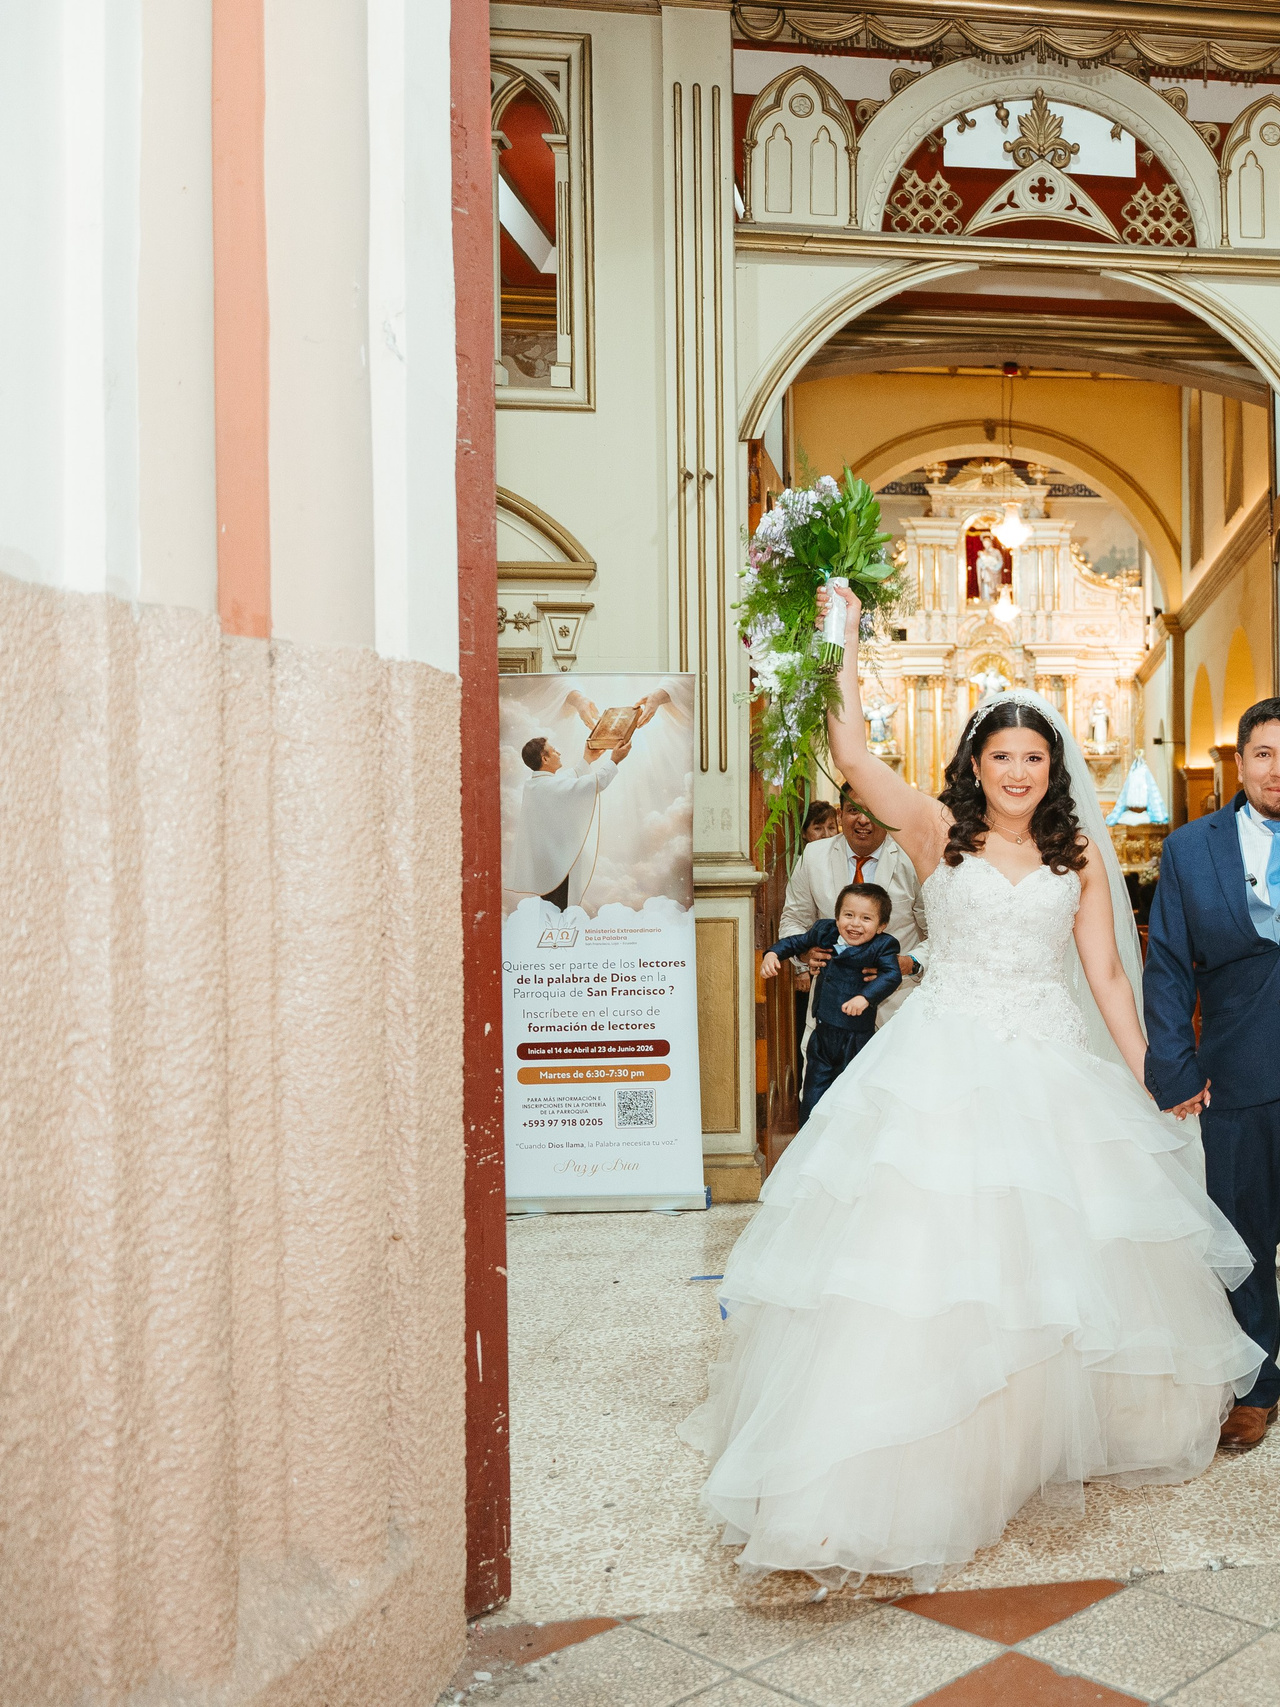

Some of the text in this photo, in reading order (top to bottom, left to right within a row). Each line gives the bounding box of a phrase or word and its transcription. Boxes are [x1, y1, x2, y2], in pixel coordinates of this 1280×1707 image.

[502, 960, 546, 973] Quieres
[569, 960, 598, 972] parte
[602, 959, 616, 969] de
[619, 958, 635, 969] los
[638, 958, 686, 968] lectores
[516, 972, 667, 987] de la palabra de Dios en la
[513, 985, 675, 1001] Parroquia de San Francisco ?
[522, 1006, 661, 1019] Inscríbete en el curso de
[528, 1020, 656, 1033] formación de lectores
[528, 1047, 546, 1055] Inicia
[573, 1045, 590, 1054] Abril
[607, 1045, 617, 1053] de
[617, 1045, 635, 1053] Junio
[539, 1069, 645, 1080] Martes de 6:30-7:30 pm
[561, 1119, 577, 1127] 918
[579, 1118, 603, 1126] 0205
[565, 1141, 586, 1149] llama,
[595, 1140, 620, 1148] Palabra
[622, 1139, 650, 1147] necesita
[553, 1159, 588, 1177] Paz
[601, 1157, 640, 1173] Bien
